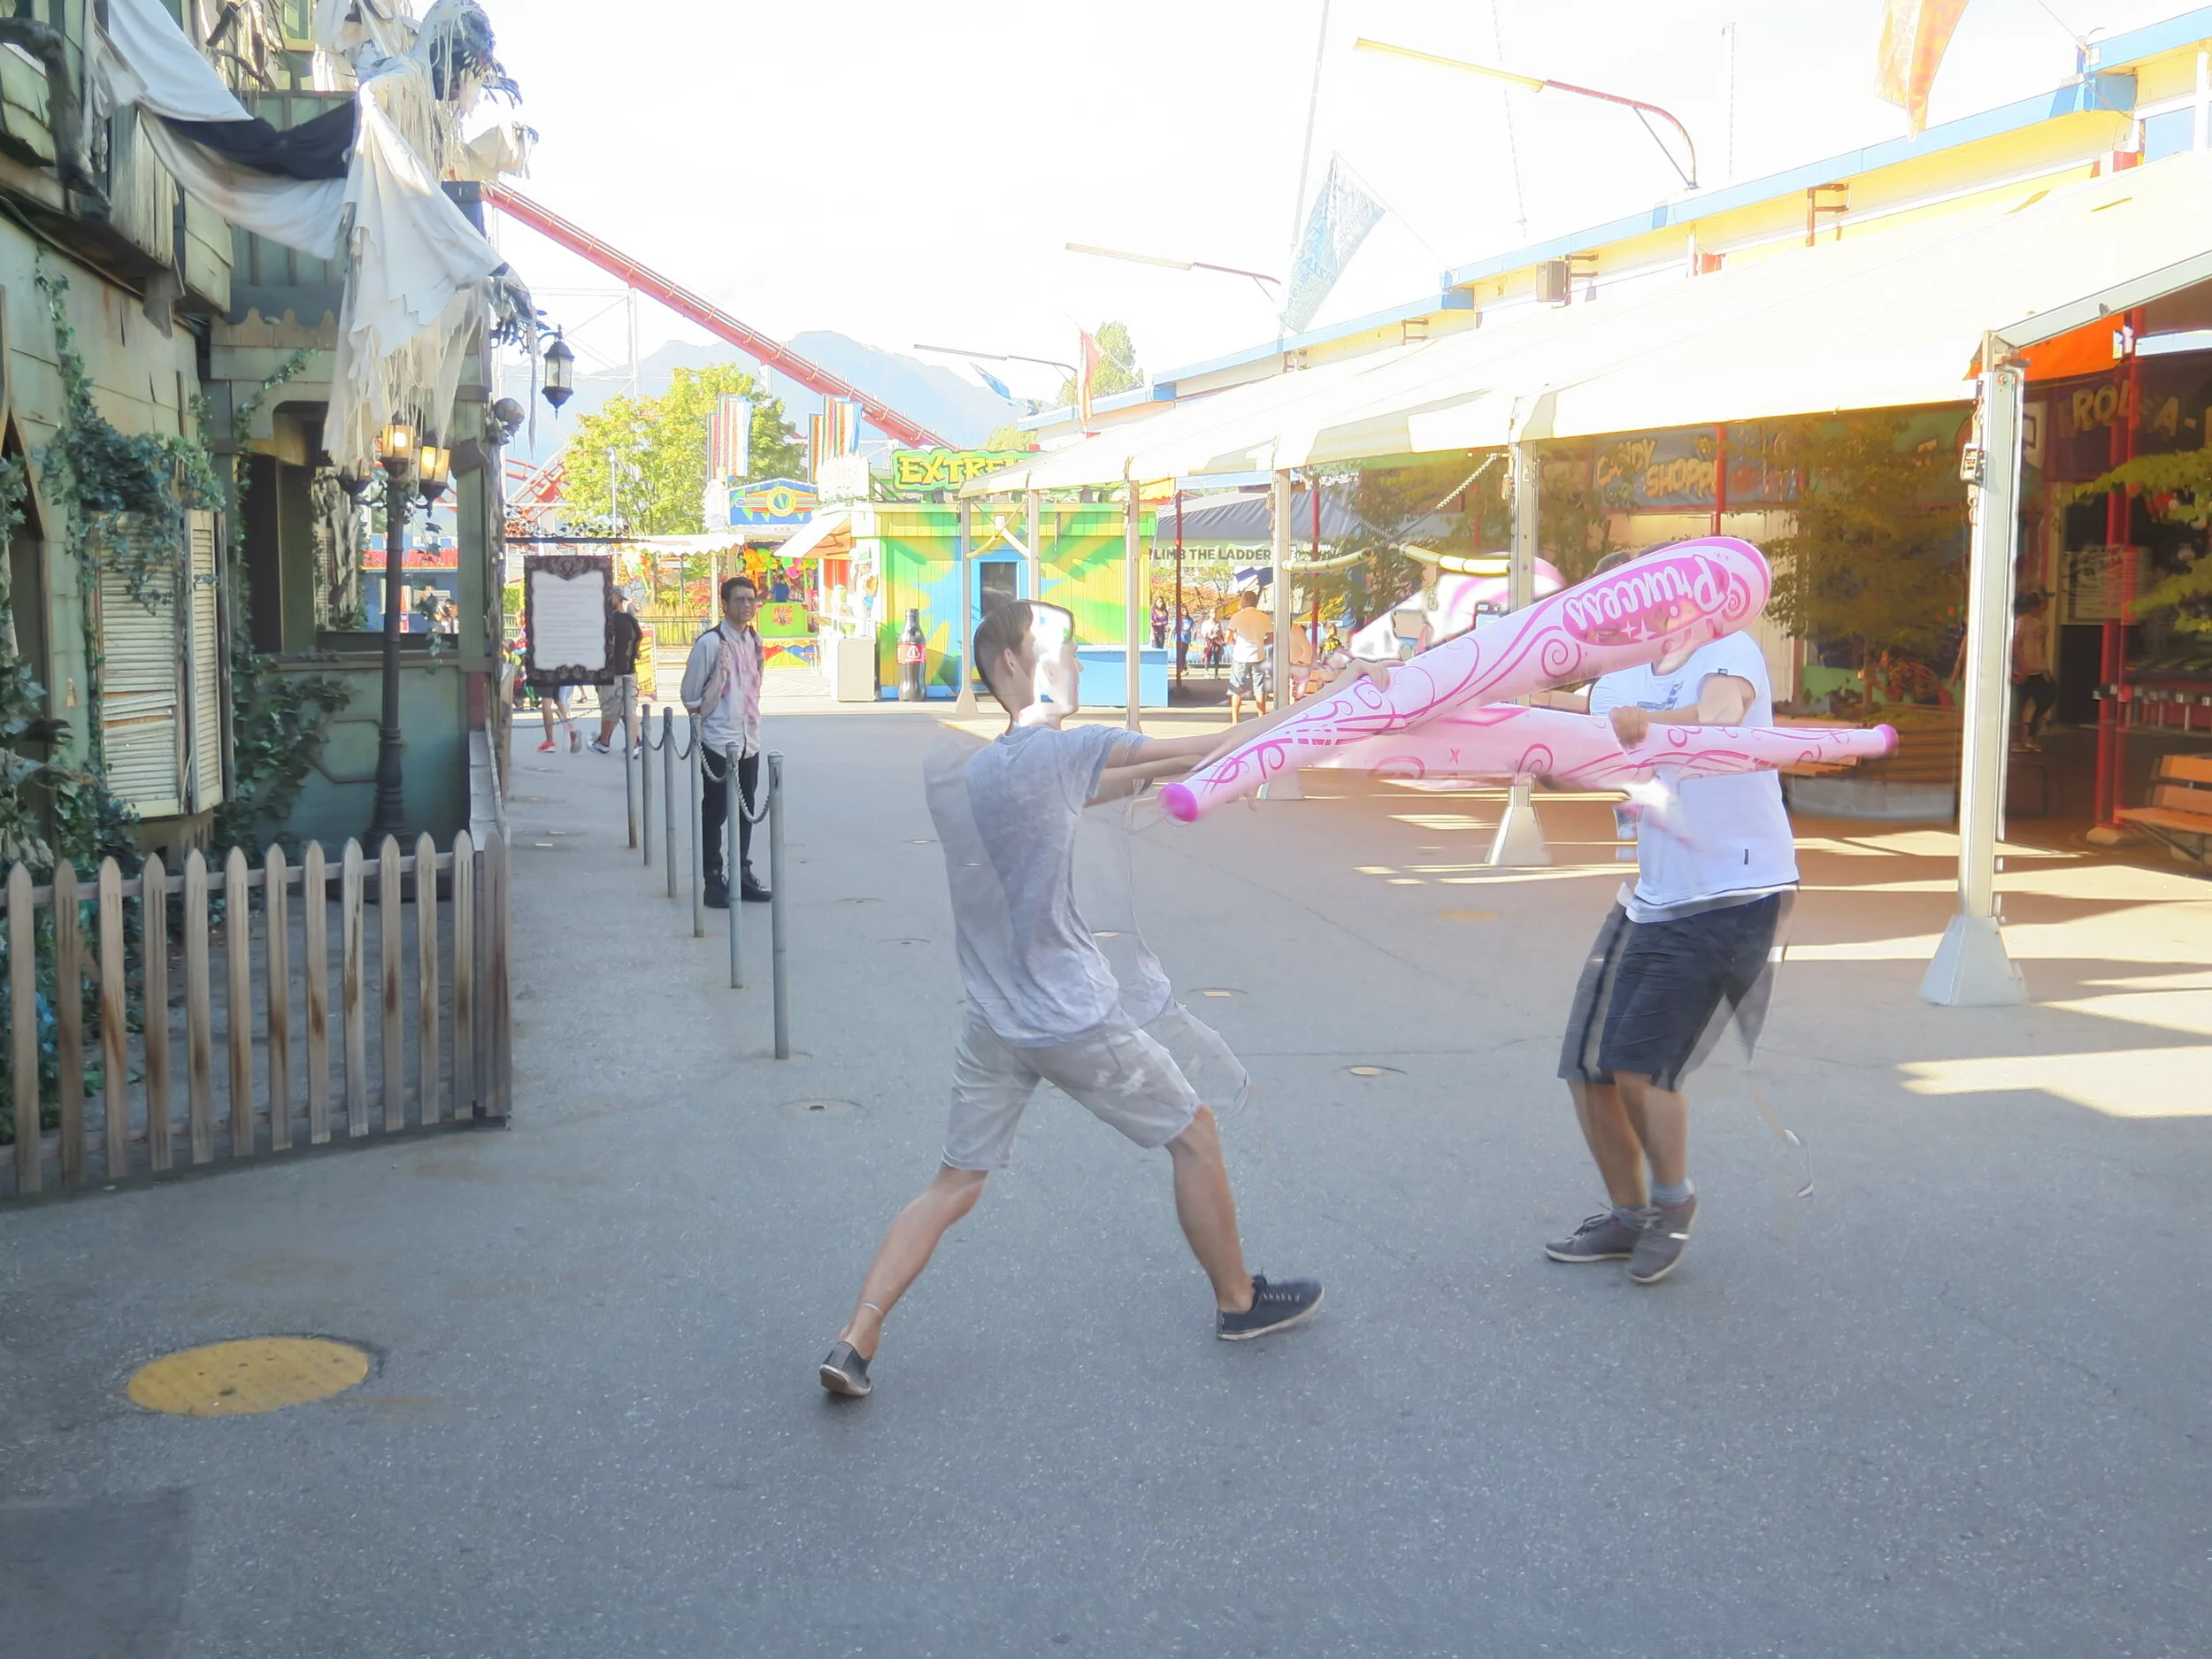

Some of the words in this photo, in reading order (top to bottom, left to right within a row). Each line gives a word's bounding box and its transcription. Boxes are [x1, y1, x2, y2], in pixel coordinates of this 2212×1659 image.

[899, 456, 1026, 484] EXTRE
[1646, 457, 1717, 498] SHOPP
[1189, 549, 1215, 560] THE
[1218, 549, 1271, 560] LADDER
[1565, 555, 1725, 630] Princess
